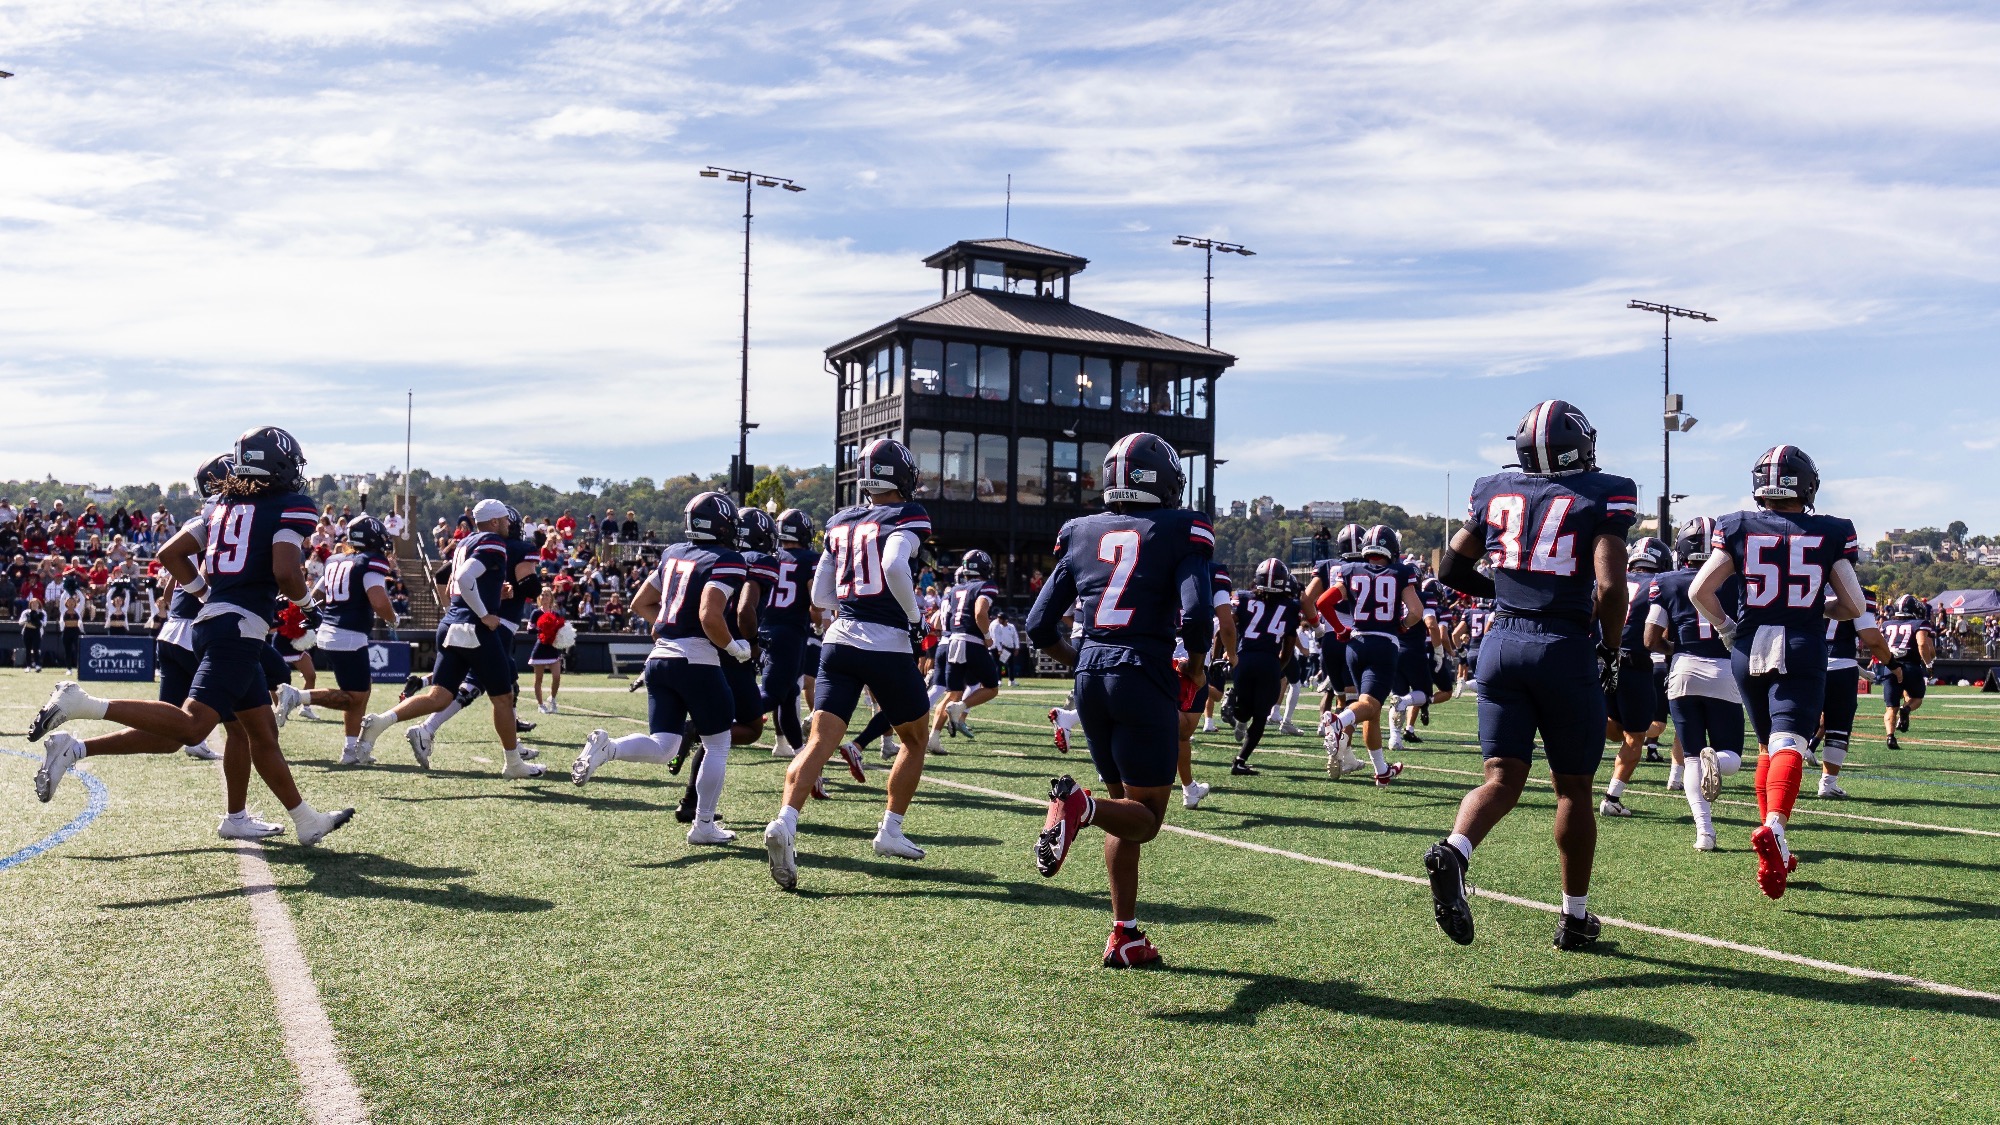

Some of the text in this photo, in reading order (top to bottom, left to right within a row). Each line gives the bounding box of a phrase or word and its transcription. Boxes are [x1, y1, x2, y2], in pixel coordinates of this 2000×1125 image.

[829, 521, 884, 599] 20
[1486, 493, 1578, 577] 34
[656, 557, 697, 625] 17
[1095, 529, 1141, 629] 2
[1349, 574, 1397, 622] 29
[1744, 533, 1824, 609] 55
[954, 590, 968, 627] 7
[1244, 599, 1287, 644] 24
[88, 659, 145, 669] CITYLIFE
